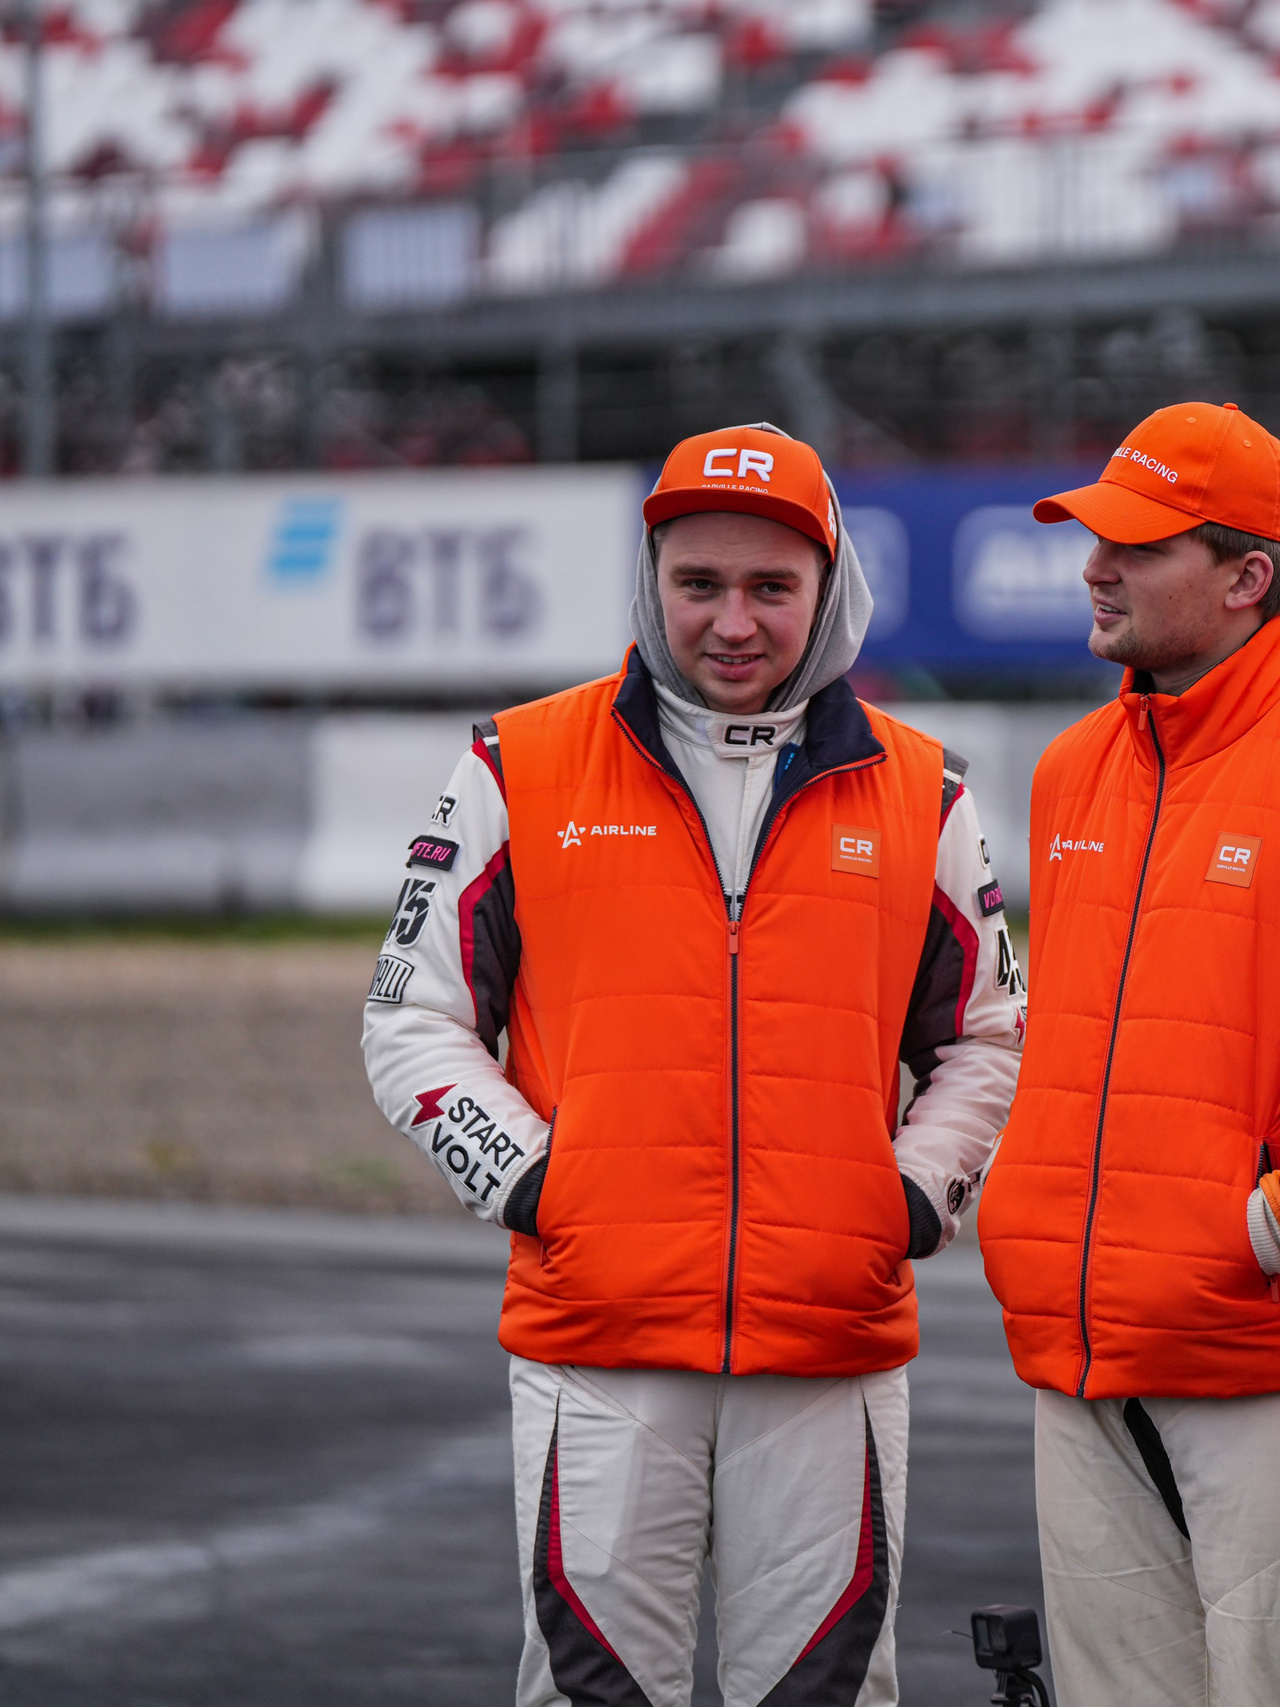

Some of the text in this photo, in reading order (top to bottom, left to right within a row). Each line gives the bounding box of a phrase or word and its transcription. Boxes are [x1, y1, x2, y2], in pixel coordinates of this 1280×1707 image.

[703, 448, 774, 483] CR
[1130, 450, 1178, 484] RACING
[724, 725, 776, 746] CR
[590, 825, 657, 836] AIRLINE
[840, 837, 873, 855] CR
[1065, 840, 1104, 853] AILINE
[1219, 845, 1251, 865] CR
[448, 1096, 526, 1173] START
[431, 1121, 502, 1202] VOLT
